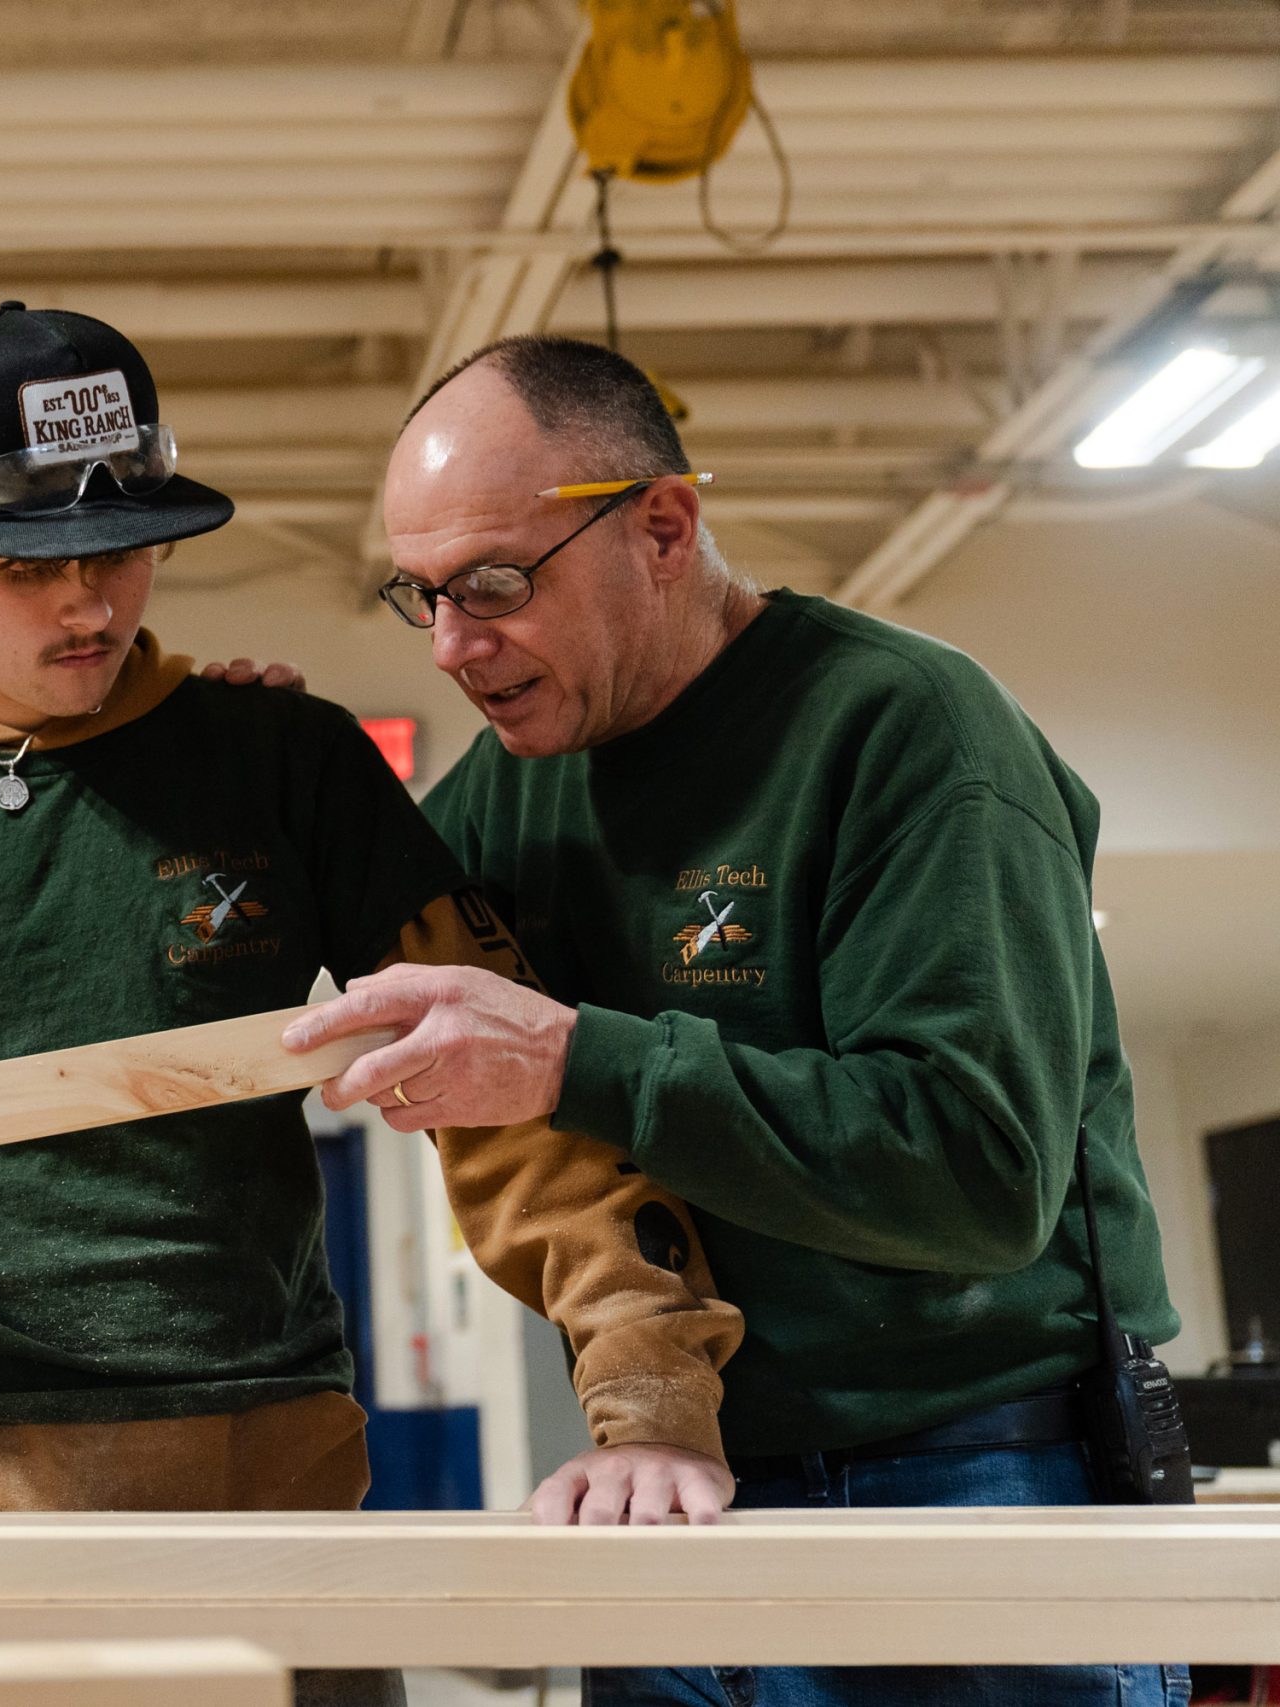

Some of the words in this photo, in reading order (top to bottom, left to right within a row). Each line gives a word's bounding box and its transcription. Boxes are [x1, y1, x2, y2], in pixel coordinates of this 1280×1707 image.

[42, 397, 66, 413] EST.
[33, 418, 81, 444] KING
[83, 405, 133, 436] RANCH
[156, 854, 210, 881] Ellis
[675, 869, 712, 890] Ellis
[716, 864, 768, 887] Tech
[662, 961, 766, 987] Carpentry
